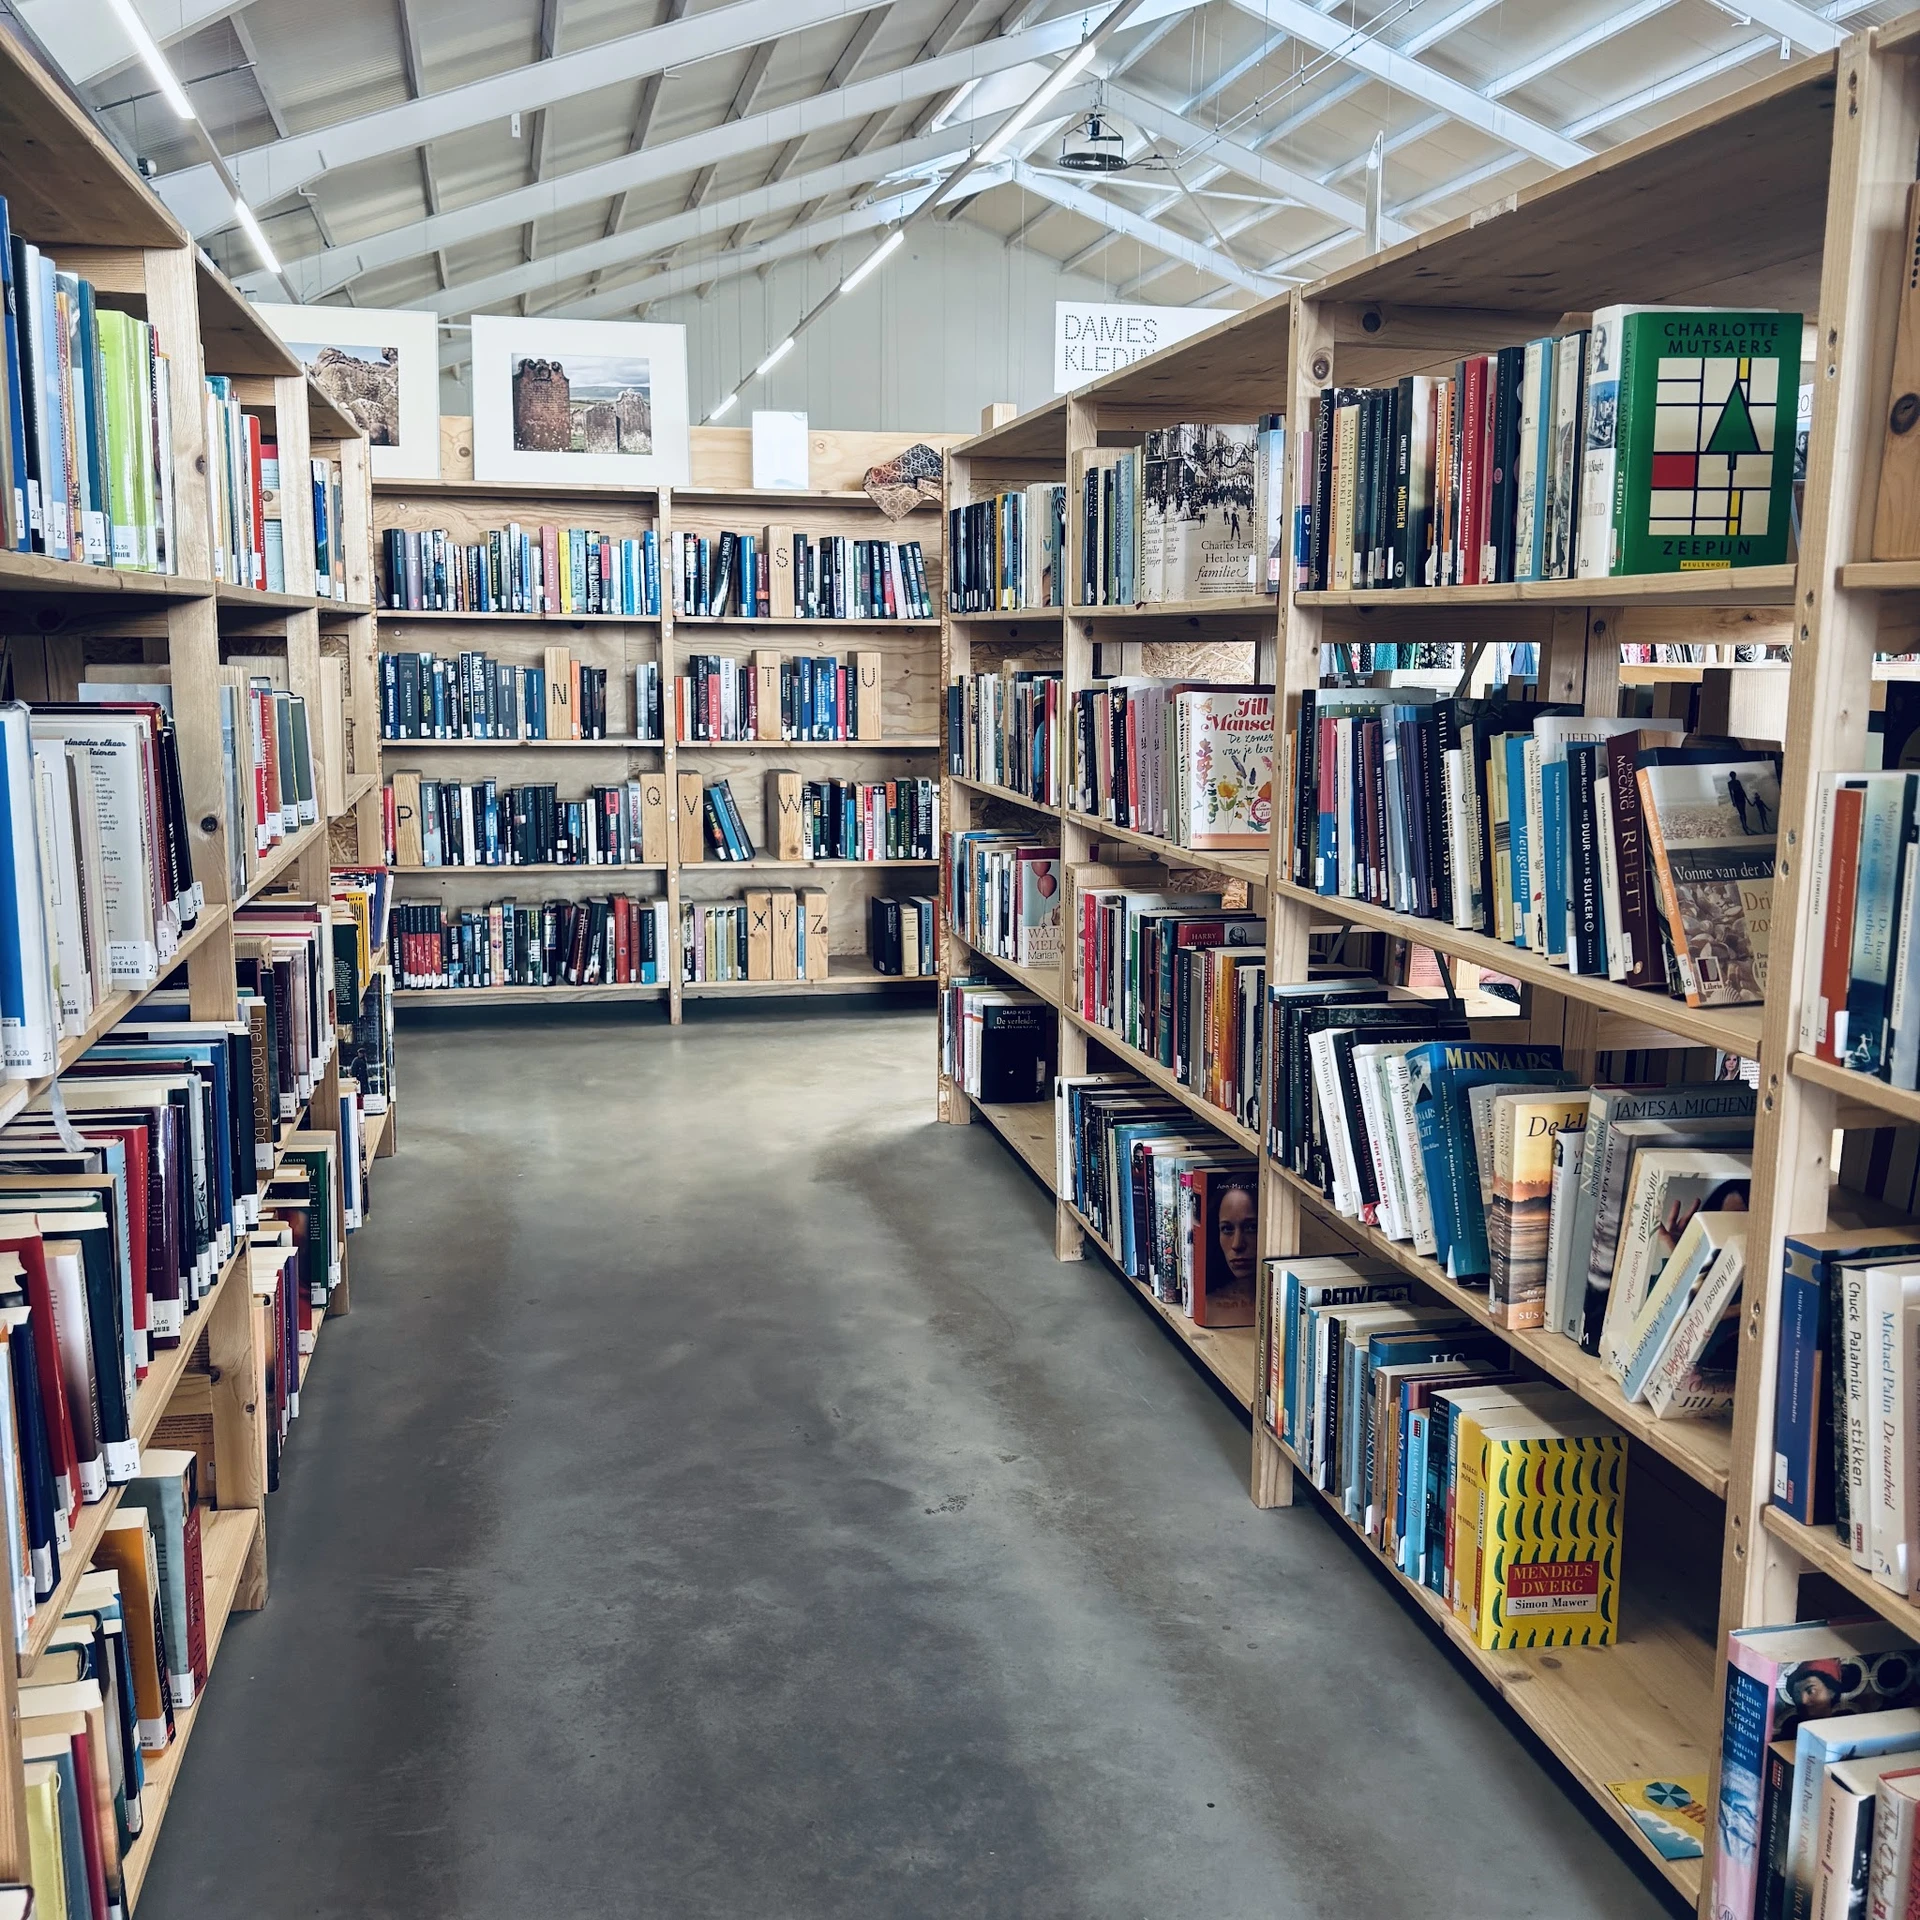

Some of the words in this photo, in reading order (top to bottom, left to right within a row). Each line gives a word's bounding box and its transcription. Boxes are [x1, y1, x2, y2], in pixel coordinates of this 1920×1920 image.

[1065, 315, 1157, 343] DAMES
[1664, 322, 1780, 337] CHARLOTTE
[1668, 339, 1773, 354] MUTSAERS
[1620, 331, 1632, 398] CHARLOTTE
[1467, 371, 1477, 414] Margriet
[1467, 416, 1474, 428] de
[1618, 402, 1628, 462] MUTSAERS
[1320, 398, 1330, 473] JACQUELYN
[1340, 420, 1349, 470] RACHELS
[1466, 430, 1475, 455] Moor
[1464, 460, 1474, 503] Mélodie
[1615, 470, 1625, 515] ZEEPIJN
[1396, 486, 1408, 529] MÄDCHEN
[56, 529, 66, 540] 21
[1462, 506, 1472, 551] d'amour
[89, 538, 102, 547] 21
[1201, 540, 1235, 551] Charles
[1662, 541, 1752, 556] ZEEPIJN
[776, 546, 789, 568] S
[1205, 553, 1224, 563] Het
[1226, 552, 1239, 563] lot
[1195, 565, 1238, 582] familie
[761, 666, 775, 688] T
[861, 667, 876, 688] U
[552, 683, 567, 705] N
[1234, 697, 1269, 717] Jill
[1227, 732, 1241, 744] De
[1222, 748, 1240, 756] van
[1580, 751, 1588, 776] Cynthia
[1616, 755, 1630, 810] McCAIG
[1625, 763, 1636, 809] DONALD
[646, 786, 661, 807] Q
[683, 795, 698, 816] V
[778, 793, 802, 814] W
[397, 805, 413, 827] P
[1581, 823, 1592, 850] DUUR
[1442, 850, 1450, 876] 1933
[1517, 825, 1531, 900] Vleugellam
[1674, 864, 1713, 882] Vonne
[1716, 866, 1738, 879] van
[1741, 863, 1760, 877] der
[1621, 831, 1642, 917] RHETT
[1584, 878, 1594, 920] SUIKER
[753, 910, 768, 931] X
[779, 909, 791, 929] Y
[810, 914, 827, 935] Z
[1878, 917, 1887, 934] De
[1874, 939, 1885, 973] hand
[1703, 982, 1725, 991] Libris
[250, 1017, 265, 1043] the
[1801, 1026, 1810, 1037] 21
[1317, 1039, 1328, 1056] Jill
[250, 1047, 267, 1092] house
[1445, 1048, 1553, 1072] MINNAARS
[1319, 1056, 1333, 1097] Mansell
[1397, 1065, 1408, 1080] Jill
[1400, 1083, 1414, 1125] Mansell
[1614, 1099, 1666, 1120] JAMES
[1668, 1101, 1684, 1117] A.
[253, 1107, 268, 1124] of
[1525, 1115, 1558, 1137] De
[1580, 1114, 1600, 1195] POLEN
[1448, 1154, 1456, 1178] DAGEN
[1647, 1169, 1658, 1189] Jill
[236, 1223, 245, 1232] 21
[1638, 1189, 1655, 1244] Mansell
[1495, 1250, 1507, 1286] hoop
[1703, 1273, 1727, 1313] Mansell
[1849, 1281, 1862, 1322] Chuck
[1881, 1310, 1896, 1374] Michael
[1848, 1331, 1862, 1401] Palahniuk
[1881, 1377, 1895, 1414] Palin
[1882, 1419, 1895, 1438] De
[1850, 1417, 1864, 1487] stikken
[124, 1463, 137, 1472] 21
[1776, 1479, 1787, 1490] 21
[1512, 1564, 1593, 1581] MENDELS
[1521, 1580, 1584, 1595] DWERG
[1515, 1597, 1549, 1610] Simon
[1552, 1597, 1589, 1609] Mawer
[1737, 1676, 1752, 1692] Het
[1731, 1707, 1756, 1730] Grazia
